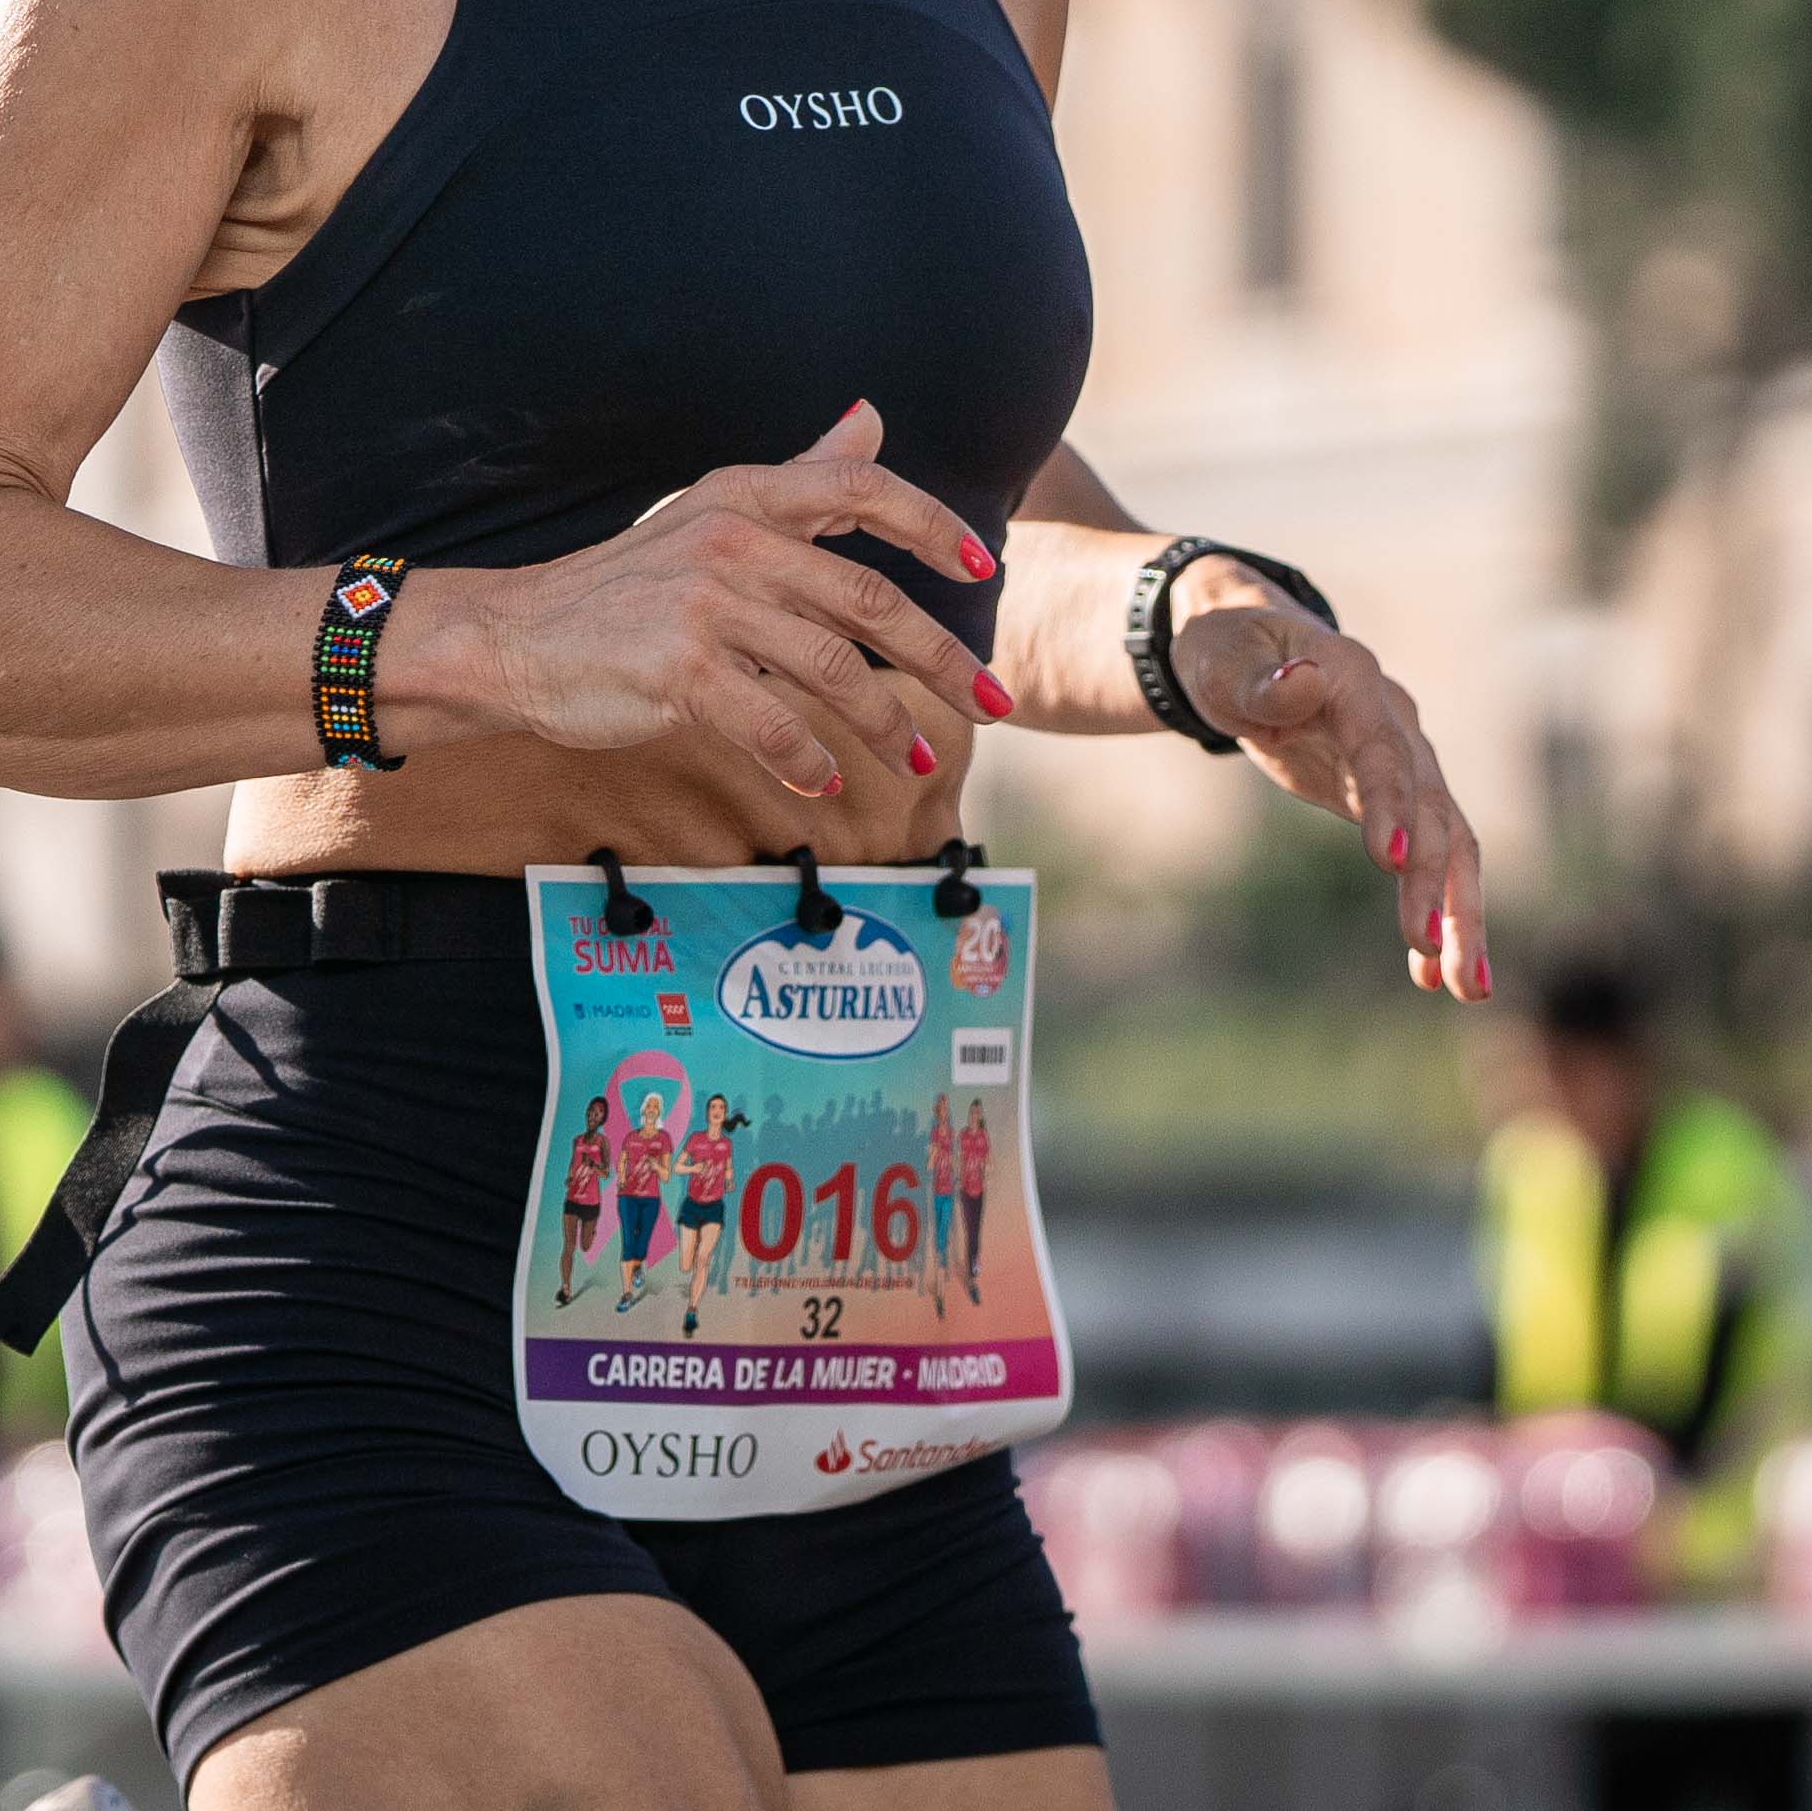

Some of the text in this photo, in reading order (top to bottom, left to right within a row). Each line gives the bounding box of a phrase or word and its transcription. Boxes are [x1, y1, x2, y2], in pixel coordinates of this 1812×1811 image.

[739, 86, 903, 130] OYSHO
[569, 917, 592, 936] TU
[961, 917, 1001, 962] 20
[573, 939, 676, 973] SUMA
[592, 1004, 652, 1019] MADRID
[740, 964, 917, 1020] ASTURIANA
[740, 1162, 921, 1262] 016
[800, 1296, 843, 1339] 32
[588, 1353, 725, 1389] CARRERA
[734, 1357, 771, 1390] DE
[772, 1357, 805, 1390] LA
[810, 1356, 897, 1390] MUJER
[917, 1352, 1007, 1390] MADRID
[581, 1429, 758, 1478] OYSHO
